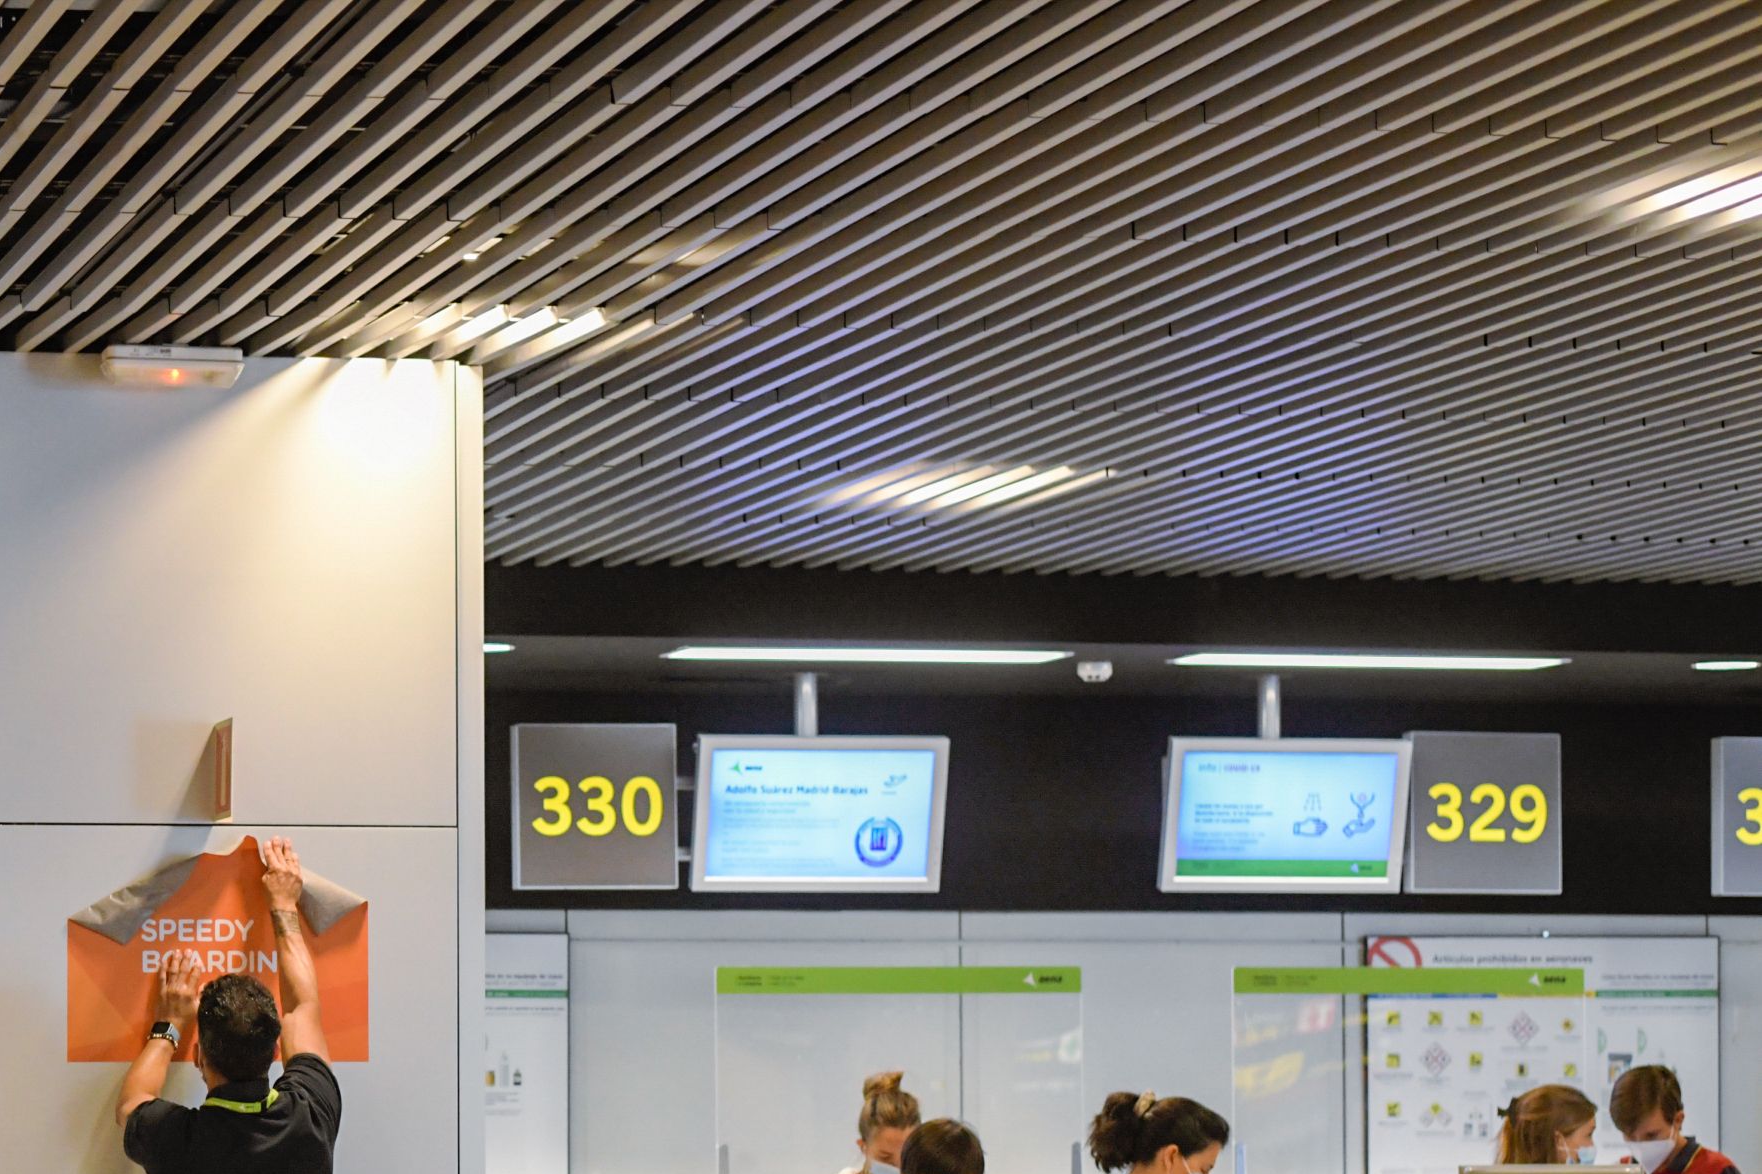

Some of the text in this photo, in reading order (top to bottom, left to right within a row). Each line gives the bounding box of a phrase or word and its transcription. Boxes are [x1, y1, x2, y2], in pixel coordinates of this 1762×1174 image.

[531, 775, 664, 837] 330
[1425, 782, 1549, 844] 329
[141, 918, 254, 943] SPEEDY
[141, 949, 279, 974] BARDIN
